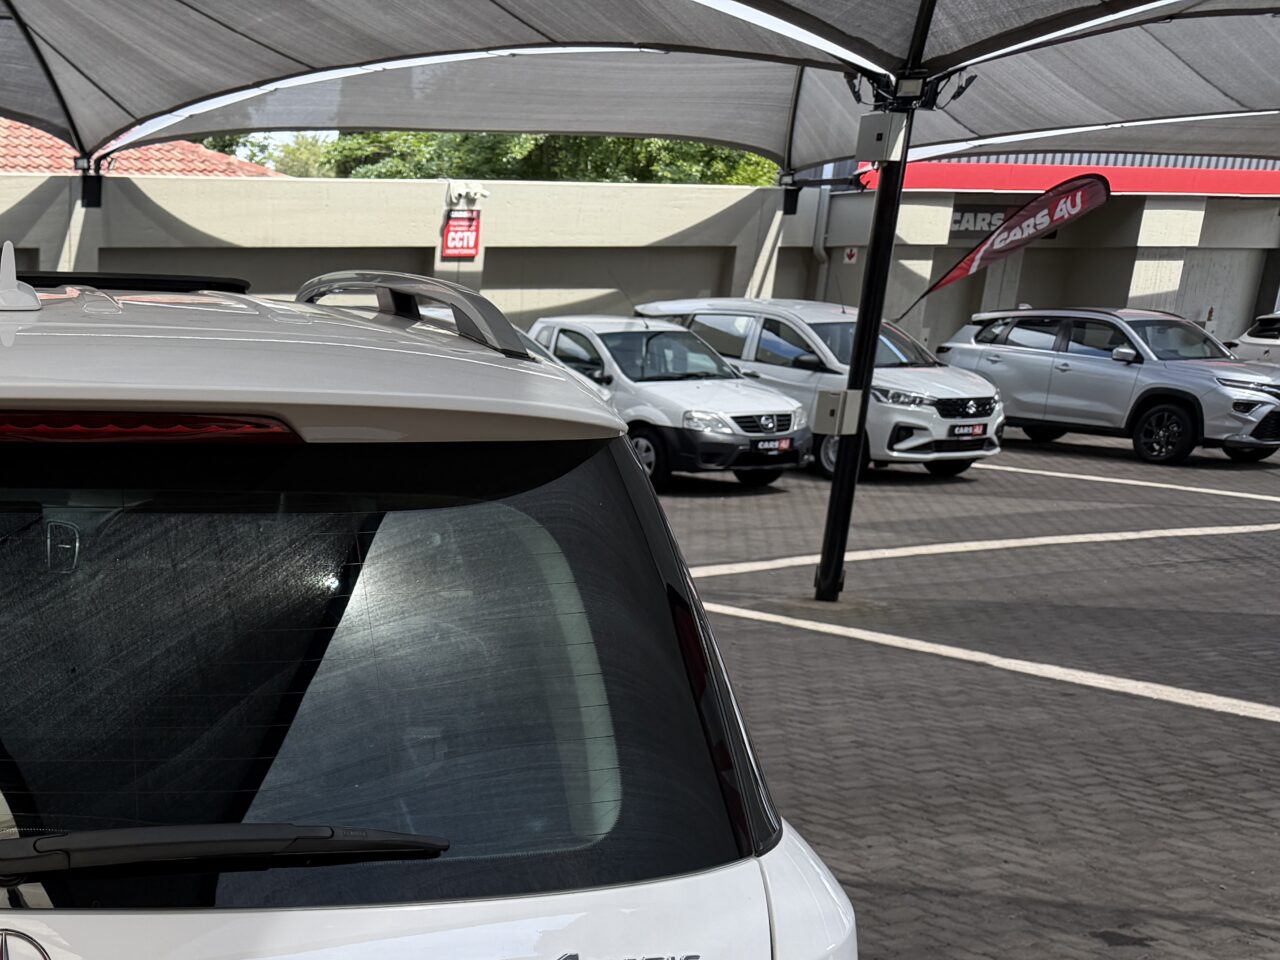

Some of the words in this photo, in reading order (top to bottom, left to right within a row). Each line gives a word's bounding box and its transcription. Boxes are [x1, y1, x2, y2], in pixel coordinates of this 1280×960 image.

[950, 211, 1006, 232] CARS
[992, 208, 1051, 250] CARS
[1053, 190, 1083, 221] 4U
[447, 231, 477, 248] CCTV
